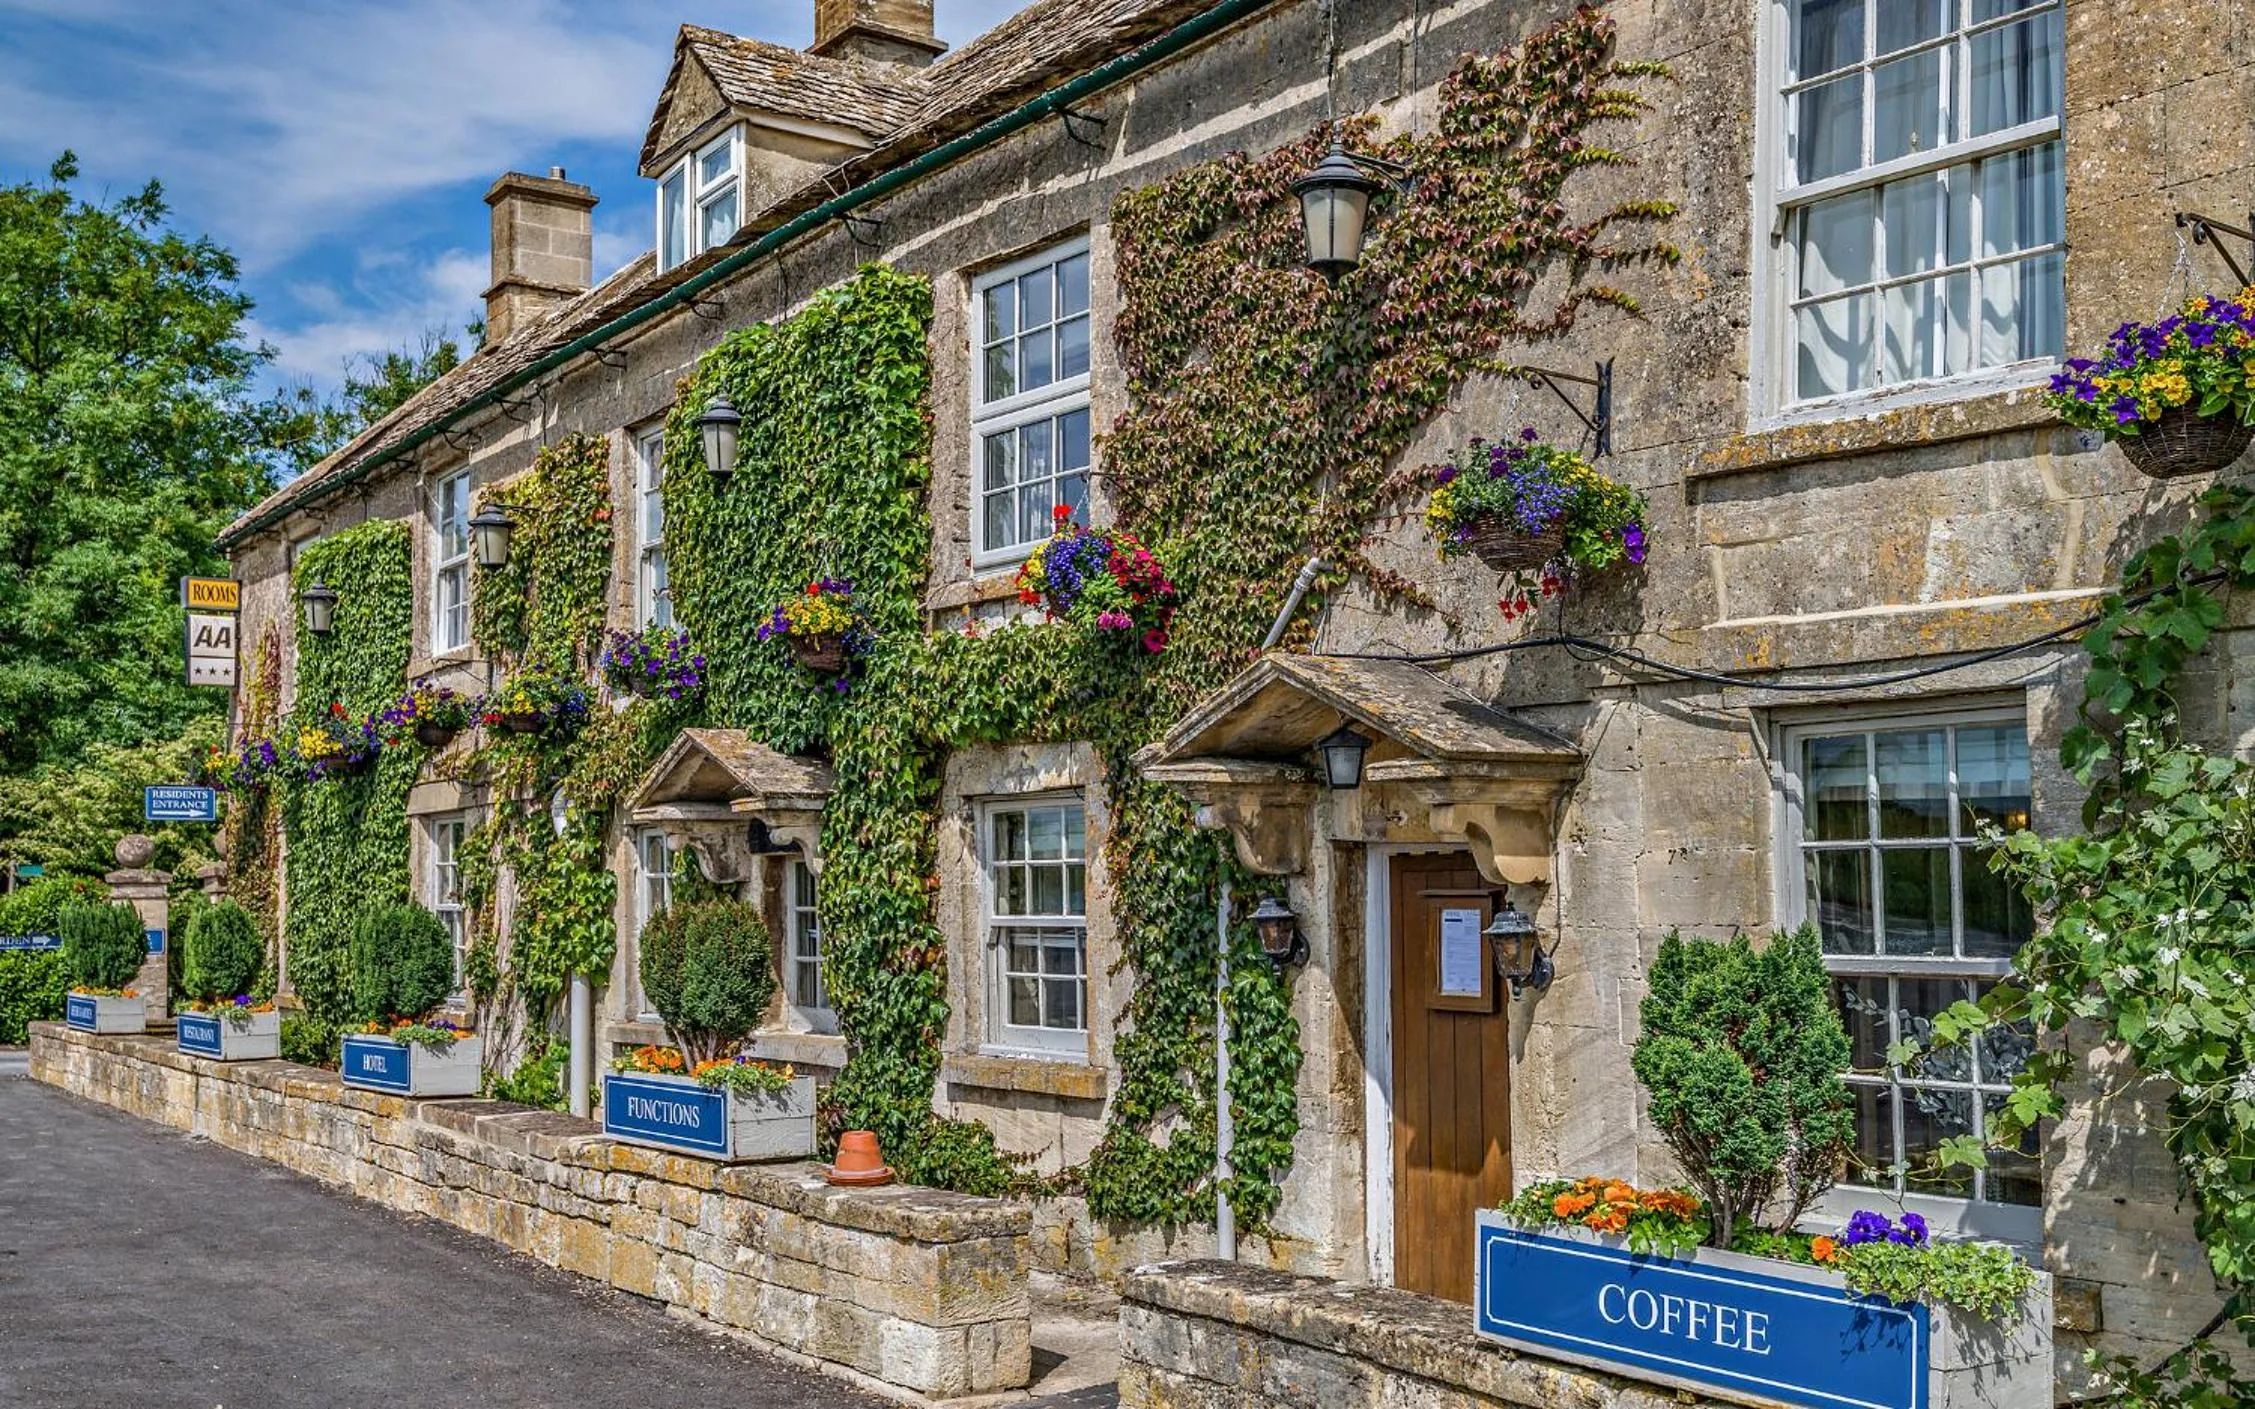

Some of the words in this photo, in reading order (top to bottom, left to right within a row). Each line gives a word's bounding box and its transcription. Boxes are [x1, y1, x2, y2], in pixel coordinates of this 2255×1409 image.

[193, 583, 237, 603] ROOMS
[193, 624, 231, 649] AA
[152, 790, 208, 799] RESIDENTS
[152, 799, 208, 809] ENTRANCE
[363, 1053, 387, 1073] HOTEL
[627, 1096, 700, 1128] FUNCTIONS
[1598, 1283, 1772, 1355] COFFEE
